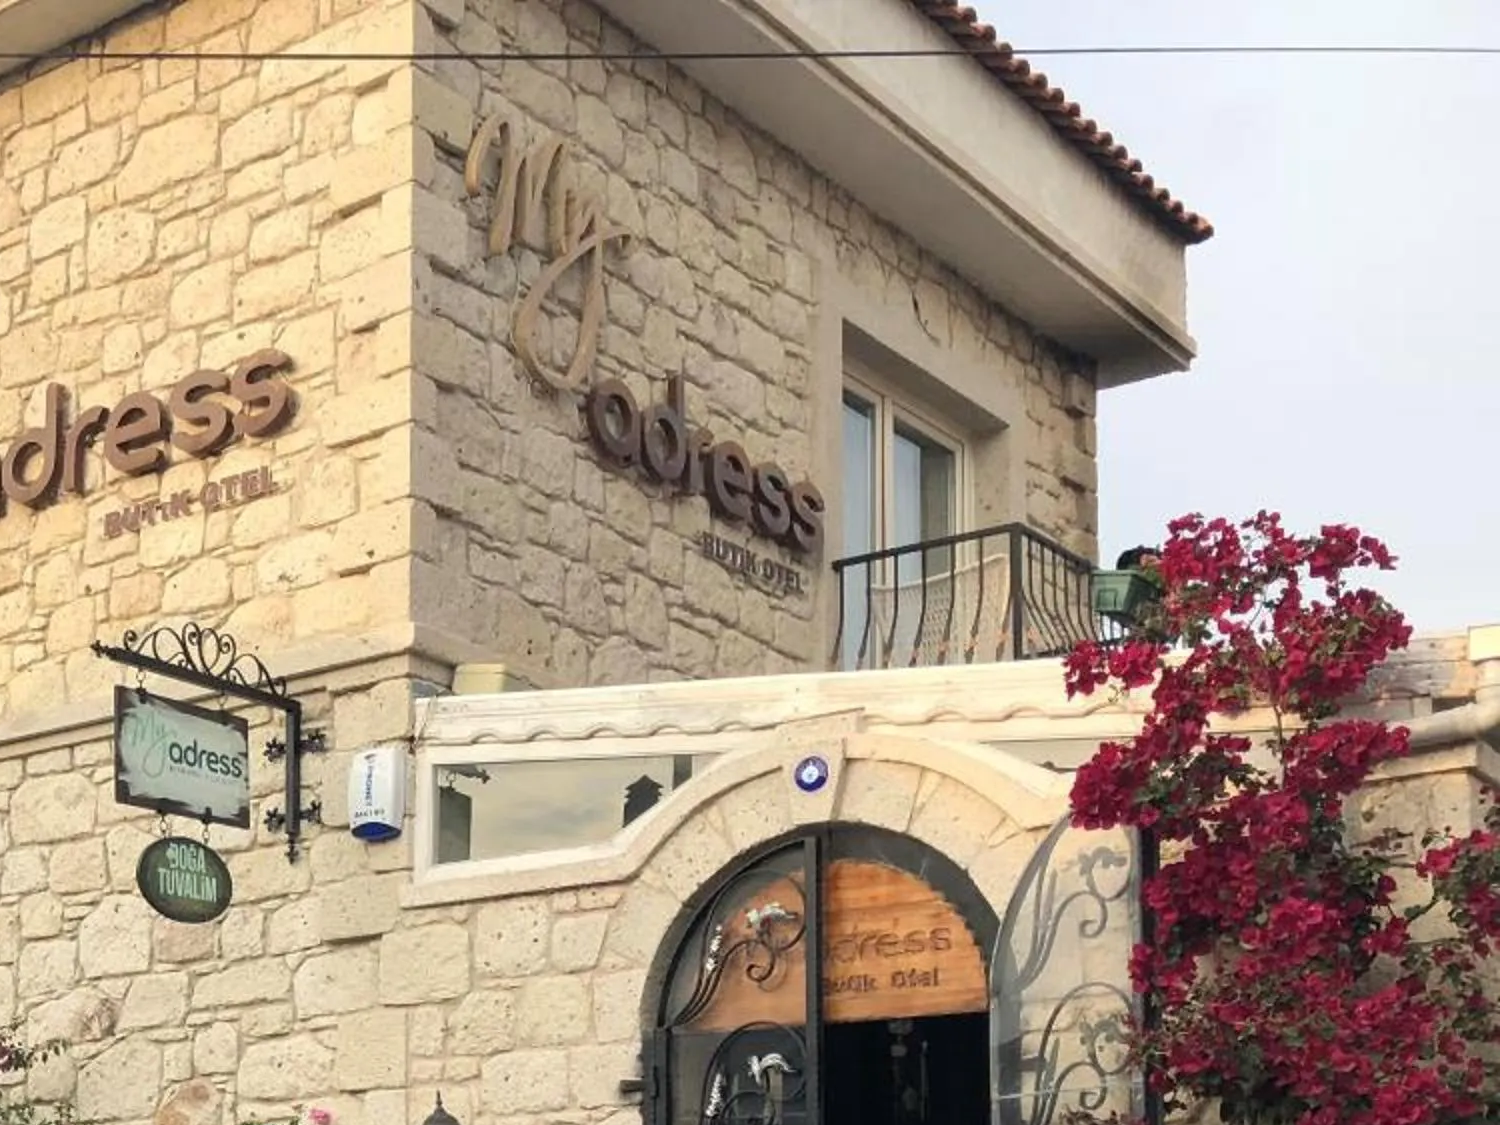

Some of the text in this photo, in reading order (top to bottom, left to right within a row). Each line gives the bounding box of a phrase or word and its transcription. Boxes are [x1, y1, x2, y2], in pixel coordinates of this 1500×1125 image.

[586, 366, 825, 552] adress
[200, 466, 277, 511] OTEL
[762, 558, 804, 594] OTEL
[169, 739, 243, 778] adress
[826, 923, 952, 964] dress
